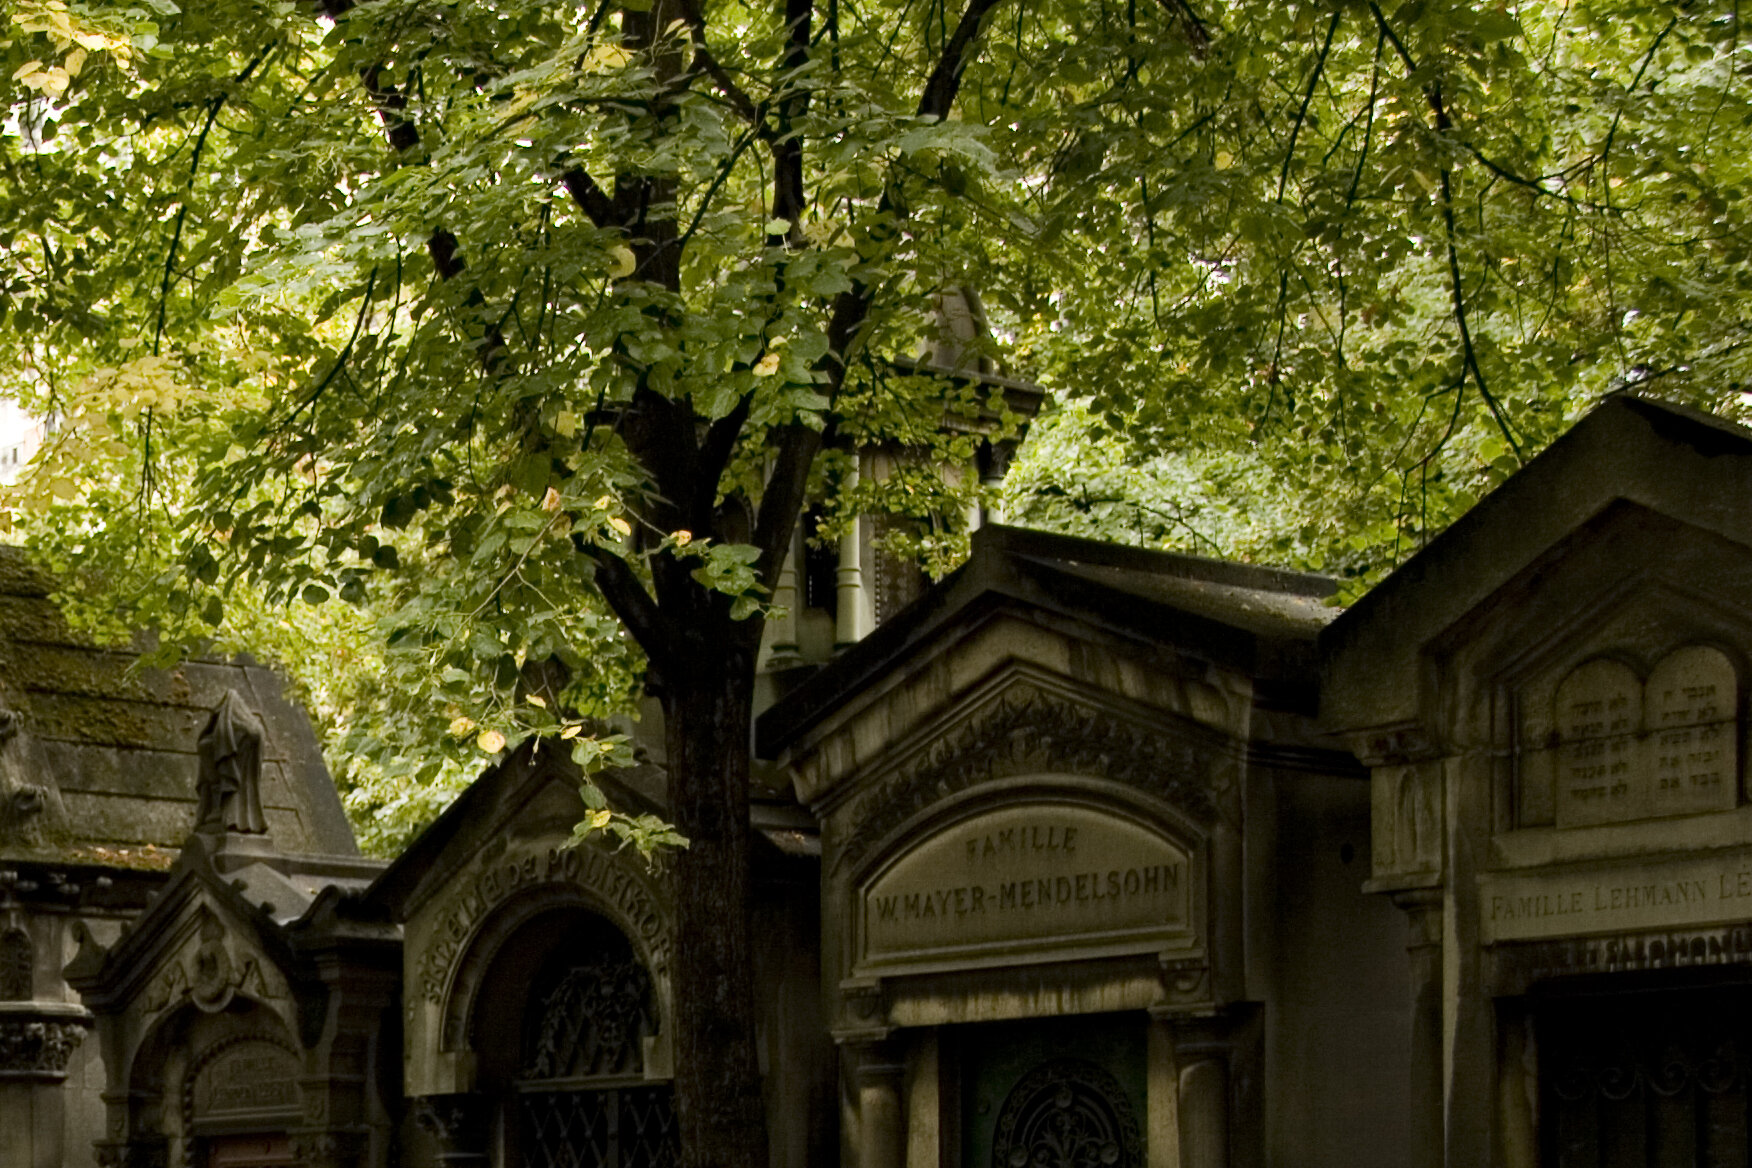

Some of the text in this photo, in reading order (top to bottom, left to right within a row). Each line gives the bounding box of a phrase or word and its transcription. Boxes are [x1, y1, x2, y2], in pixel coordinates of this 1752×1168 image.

[965, 825, 1079, 863] FAMILLE
[1489, 891, 1584, 921] FAMILLE
[1593, 879, 1708, 913] LEHMANN
